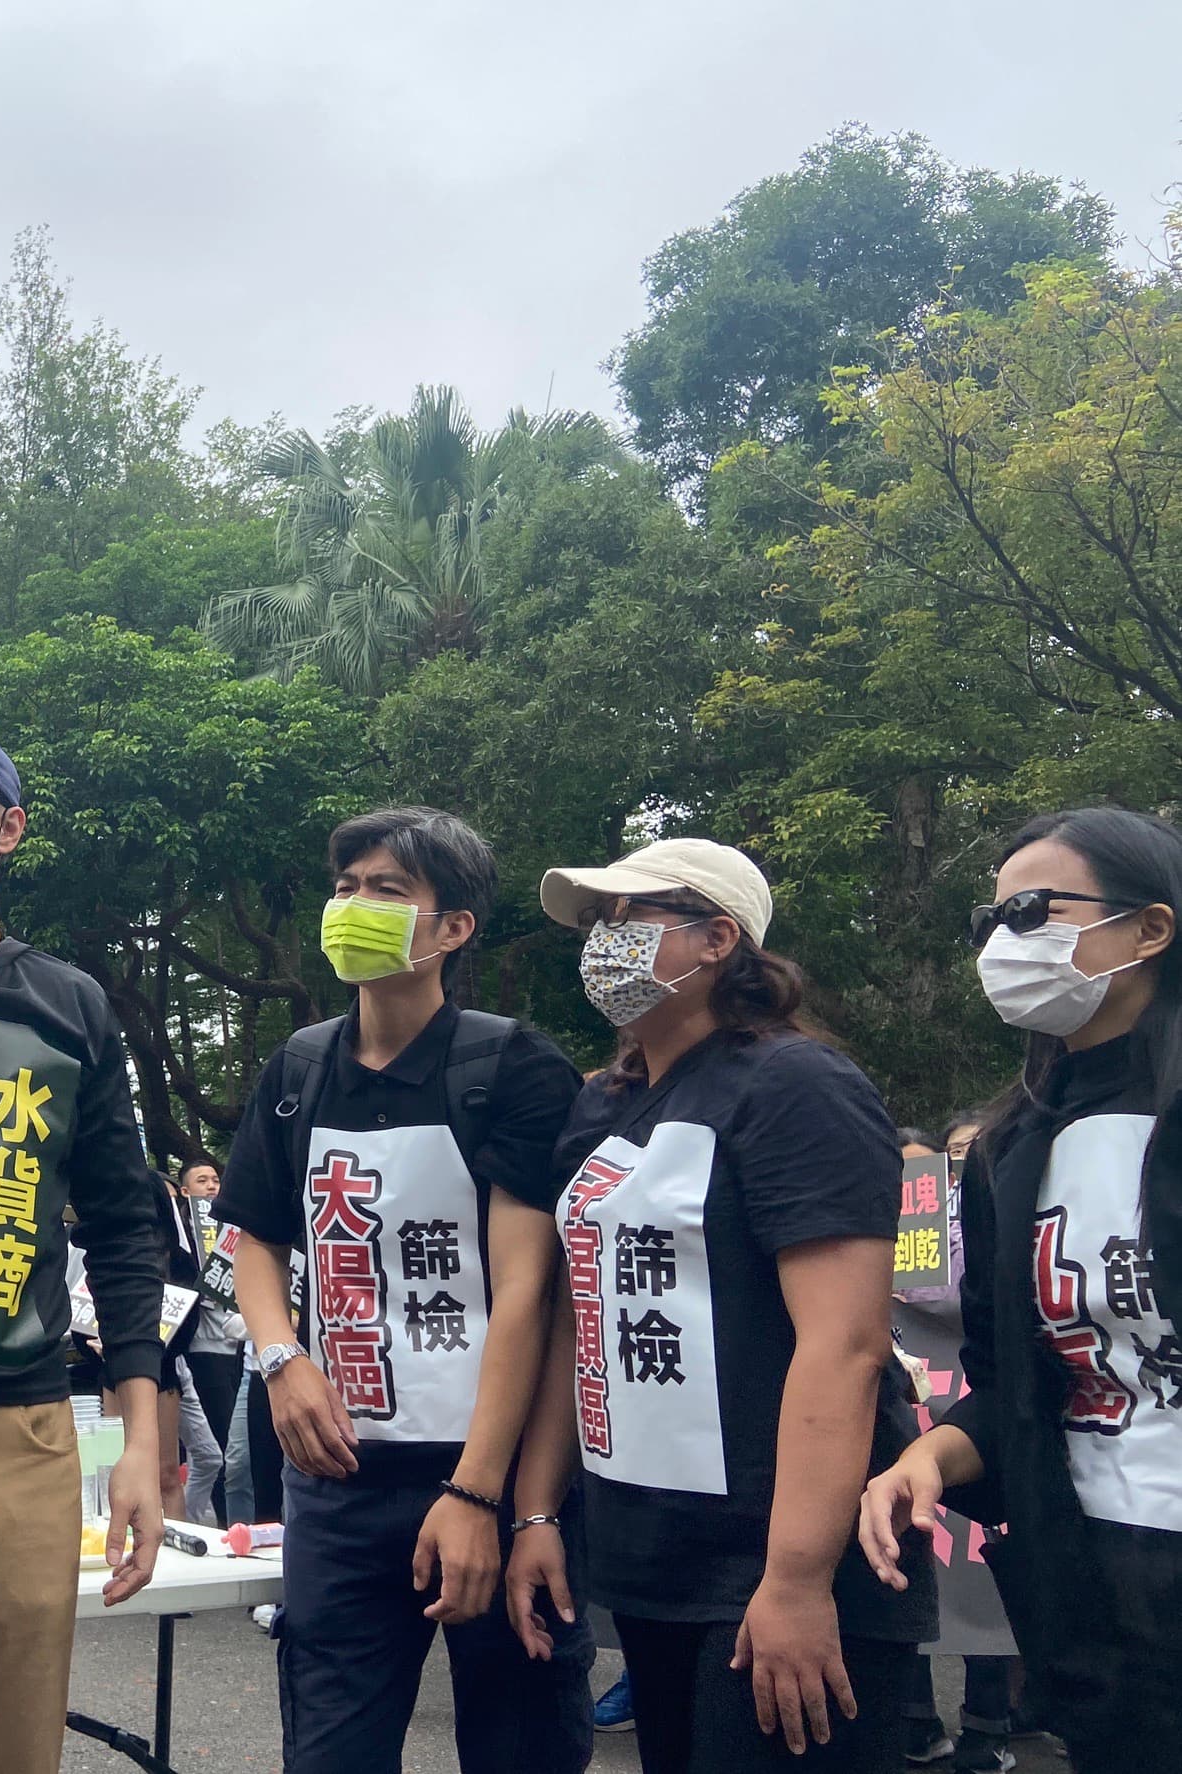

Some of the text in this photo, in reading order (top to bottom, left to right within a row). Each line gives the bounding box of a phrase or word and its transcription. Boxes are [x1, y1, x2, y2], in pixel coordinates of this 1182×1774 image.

[310, 1152, 394, 1418] 大腸癌
[397, 1219, 471, 1353] 篩檢
[564, 1157, 633, 1456] 子宮頸癌
[615, 1223, 687, 1387] 篩檢
[893, 1227, 941, 1273] 到乾
